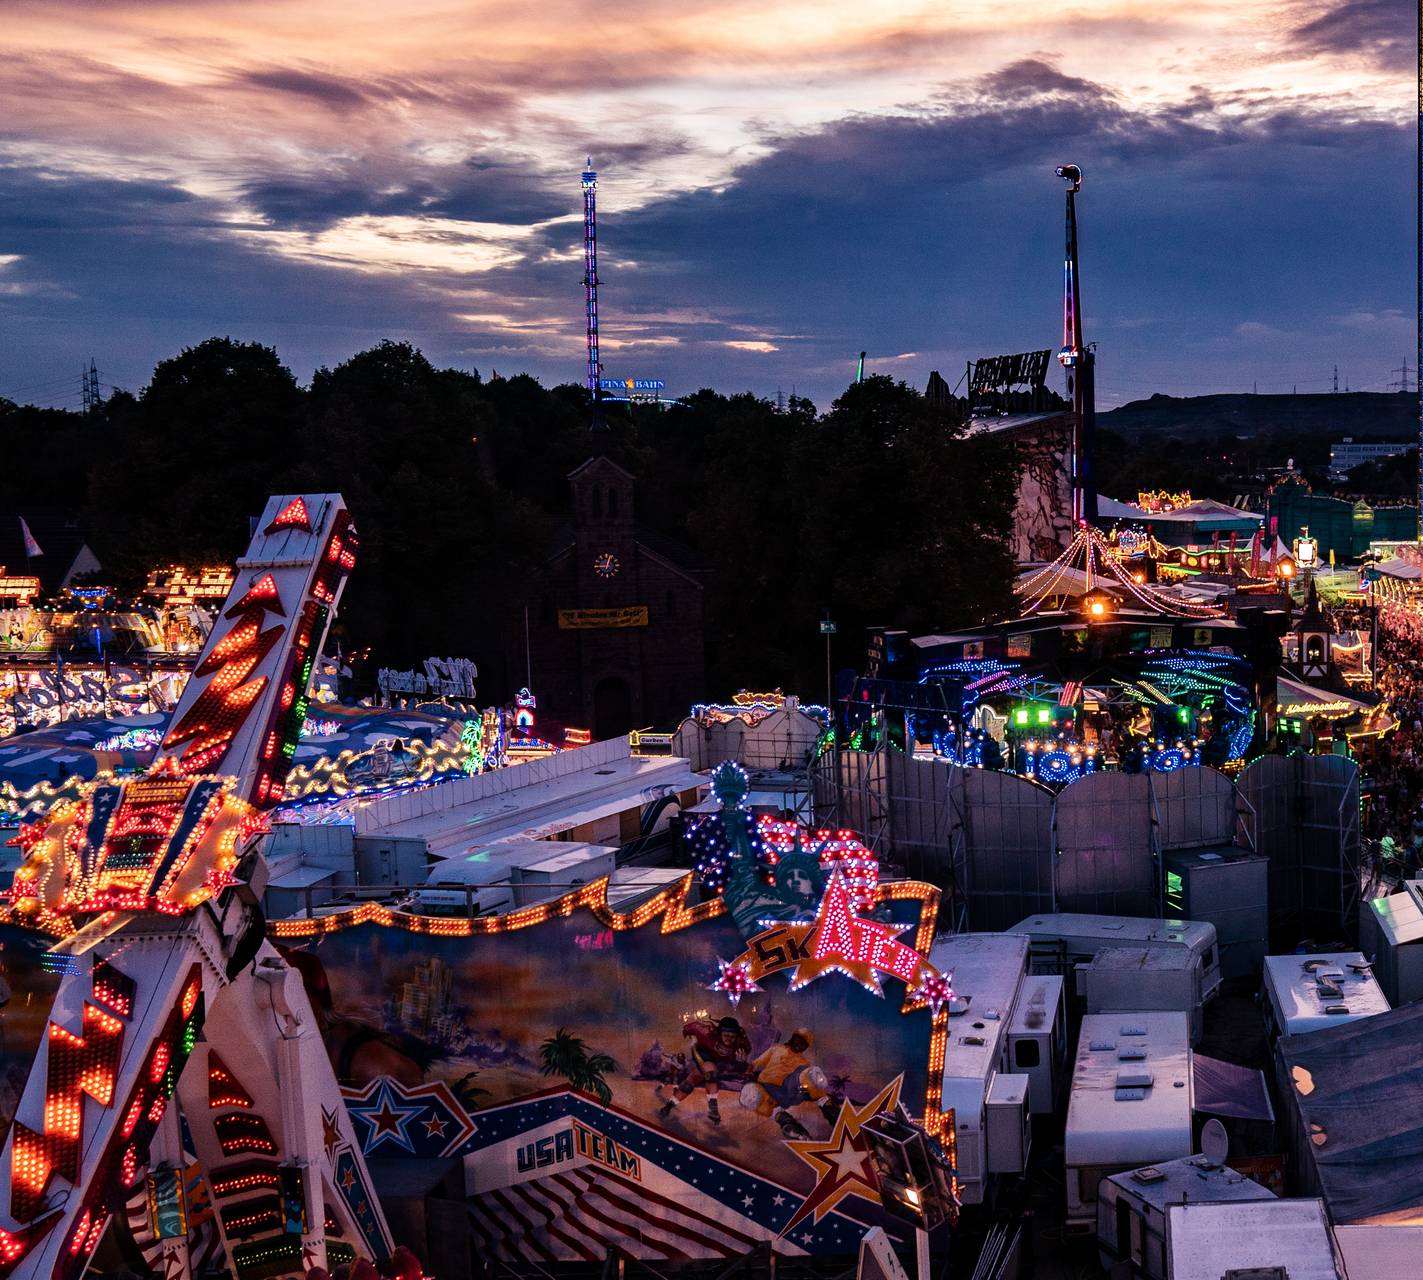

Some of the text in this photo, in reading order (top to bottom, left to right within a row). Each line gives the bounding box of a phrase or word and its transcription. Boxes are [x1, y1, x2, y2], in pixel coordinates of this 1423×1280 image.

[635, 380, 664, 389] BAHN
[517, 1122, 641, 1181] USA TEAM
